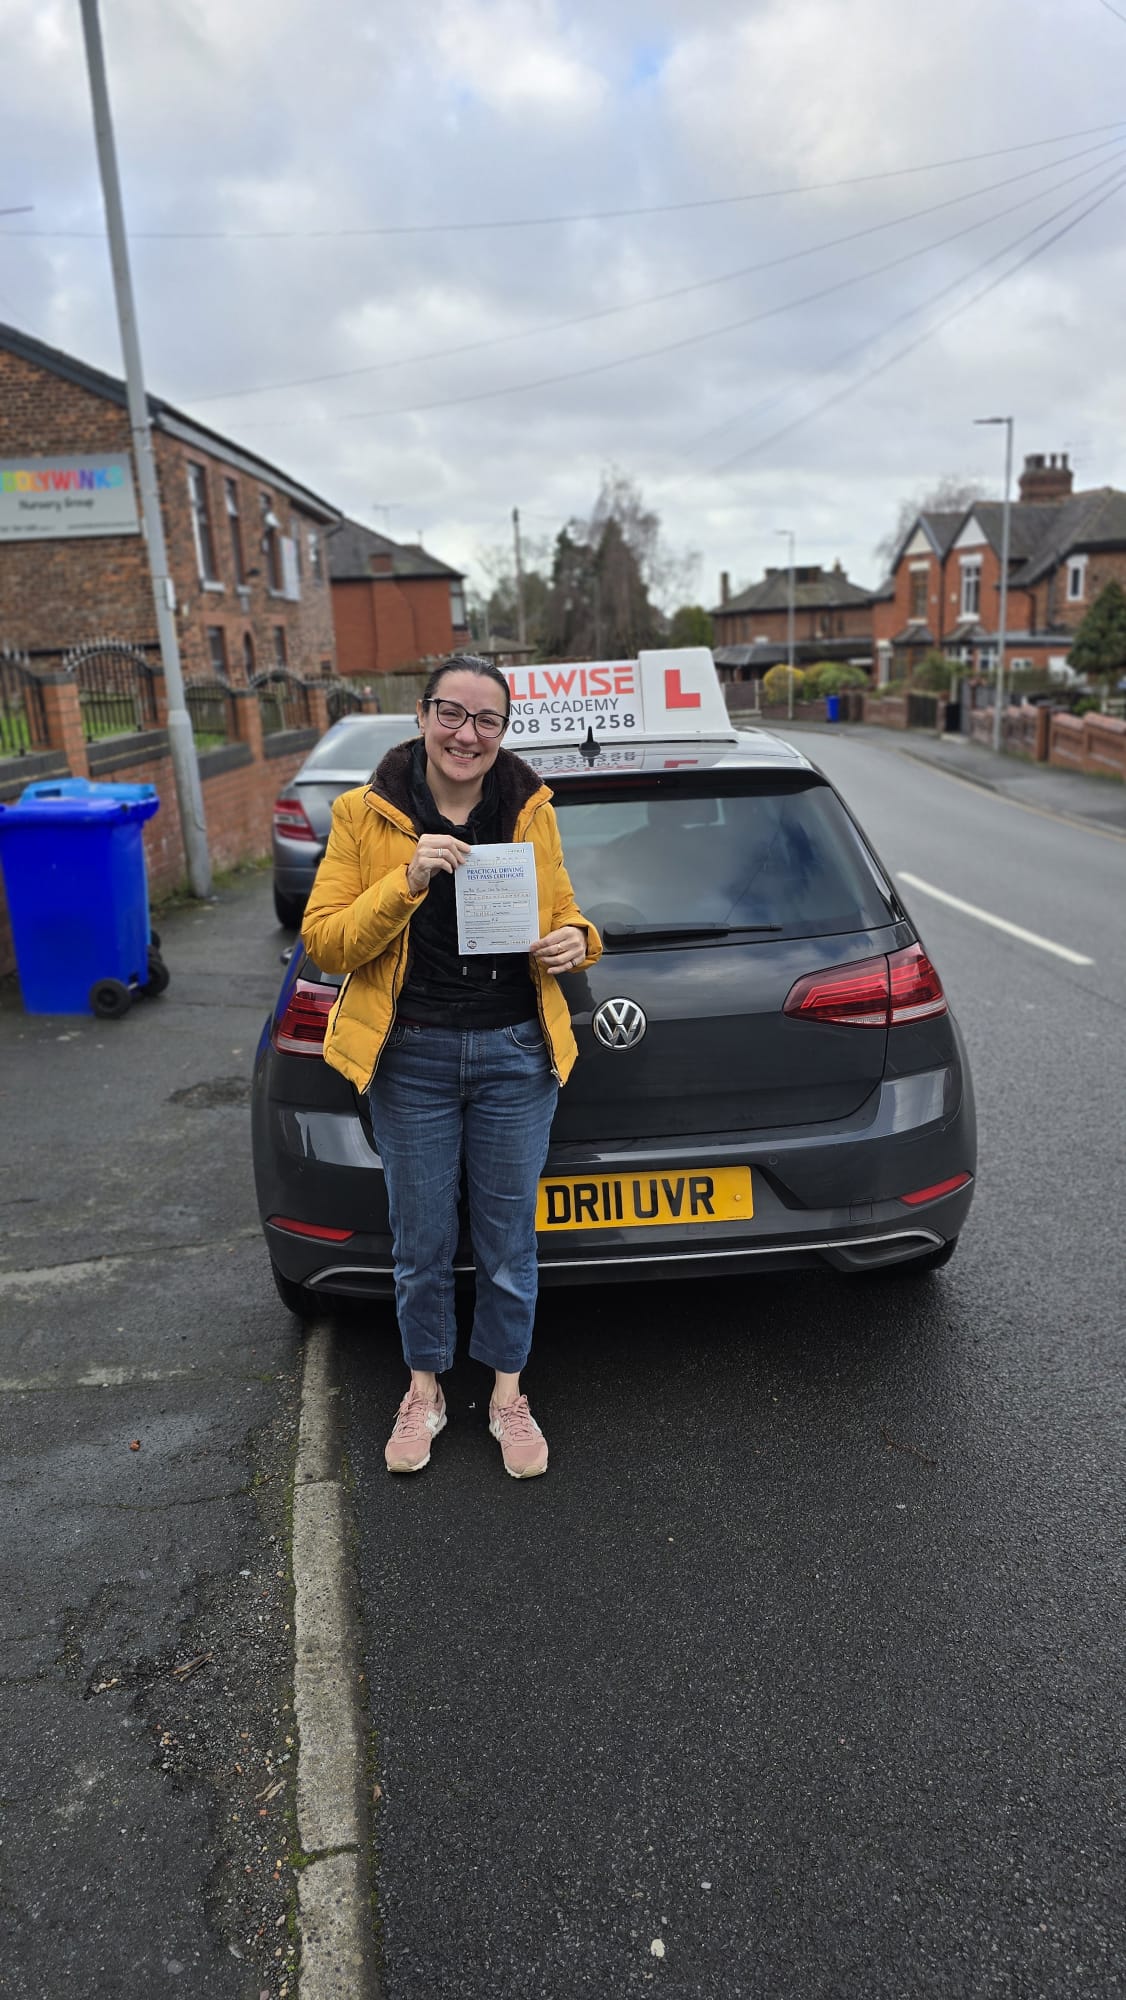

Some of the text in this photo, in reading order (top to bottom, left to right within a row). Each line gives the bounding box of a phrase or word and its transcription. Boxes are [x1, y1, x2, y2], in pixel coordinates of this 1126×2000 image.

[507, 667, 634, 701] LLWISE
[665, 669, 702, 710] L
[539, 698, 619, 715] ACADEMY
[511, 713, 636, 735] 08 521 258
[499, 866, 524, 874] DRIVING
[545, 1176, 716, 1225] DR11 UVR
